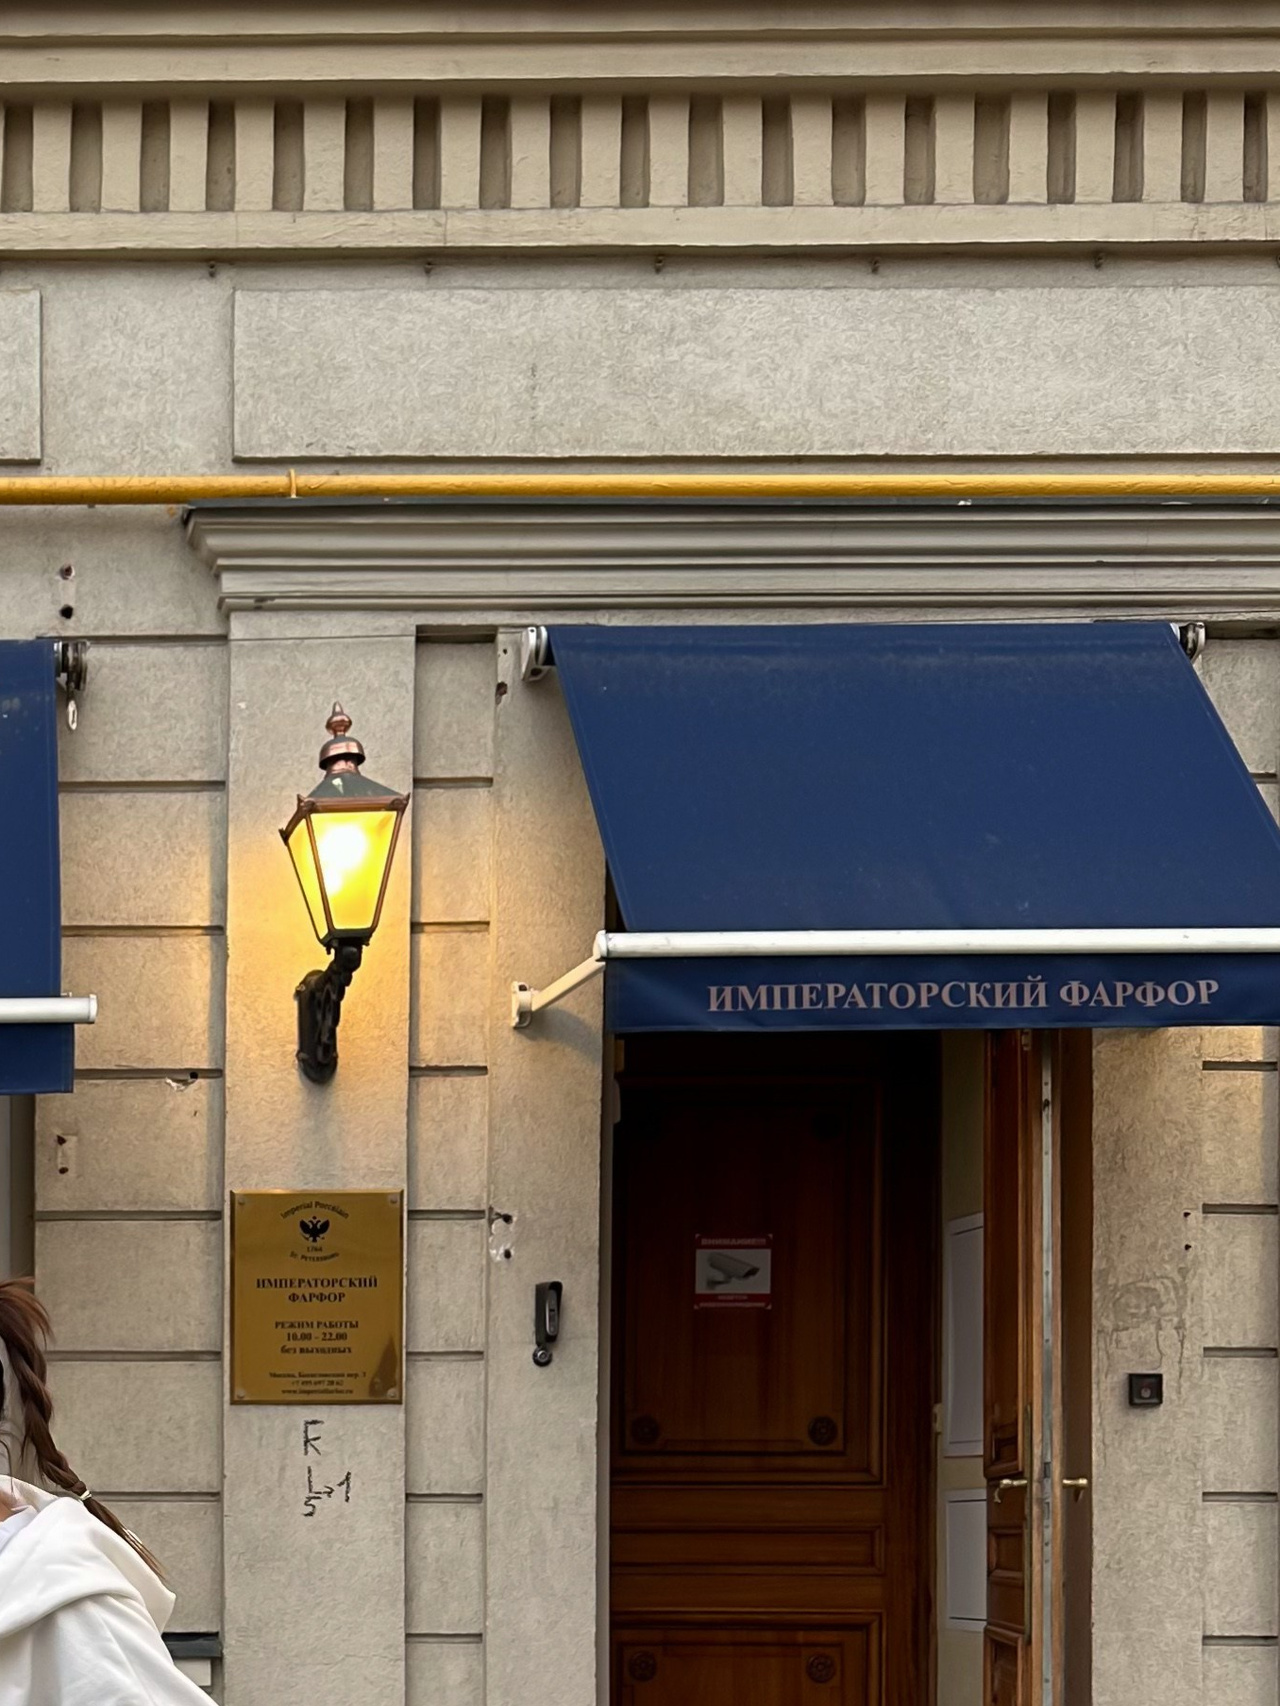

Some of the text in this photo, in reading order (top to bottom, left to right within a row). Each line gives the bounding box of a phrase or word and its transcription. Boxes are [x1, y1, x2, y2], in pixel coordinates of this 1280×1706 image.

[707, 974, 1221, 1012] ИМПЕРАТОРСКИЙ ФАРФОР
[256, 1275, 378, 1289] ИМПЕРАТОРСКИЙ
[288, 1292, 346, 1303] ФАРФОР
[275, 1320, 359, 1329] РЕЖИМ РАБОТЫ
[321, 1332, 348, 1342] 22.00
[280, 1345, 352, 1355] без выходных
